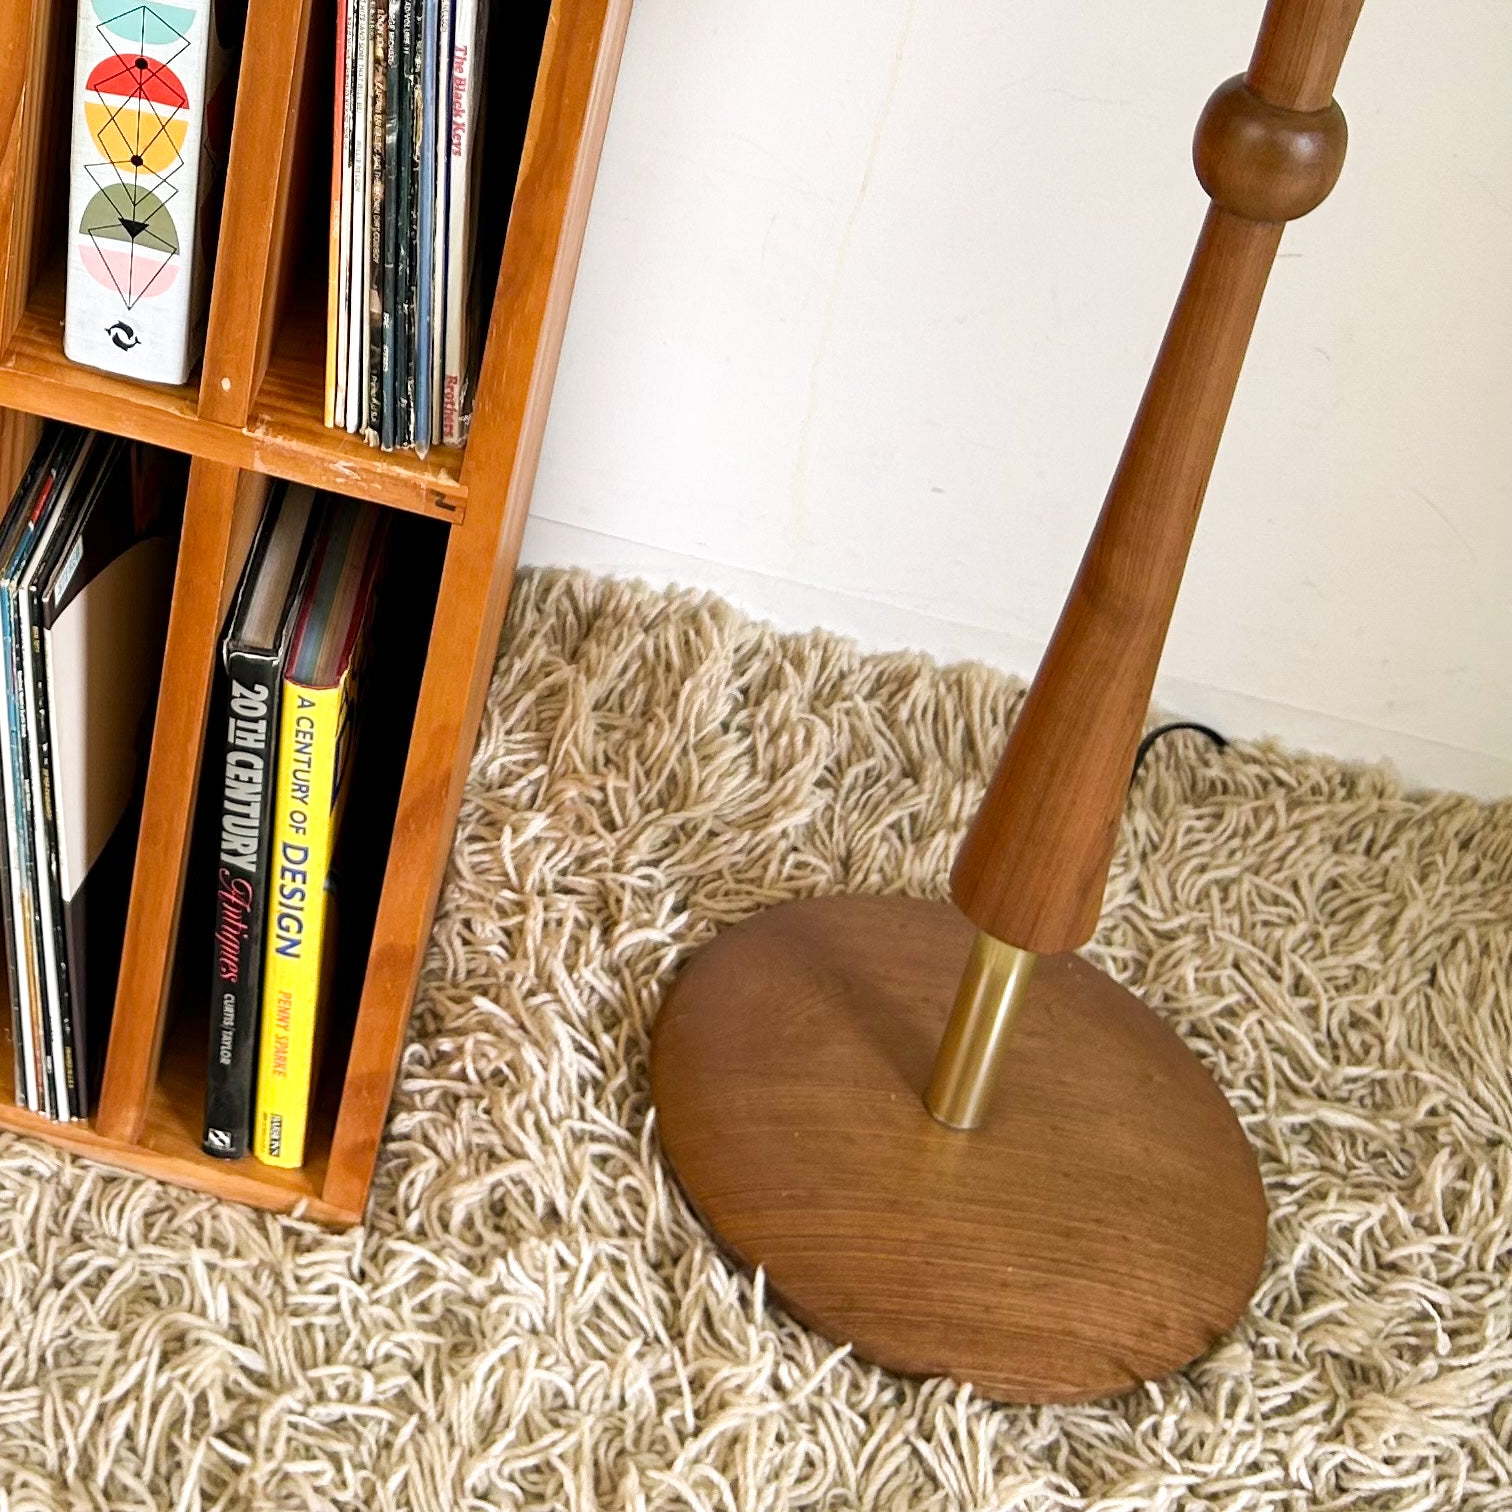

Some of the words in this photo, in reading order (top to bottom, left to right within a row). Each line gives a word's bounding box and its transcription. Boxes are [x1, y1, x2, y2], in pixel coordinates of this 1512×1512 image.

[453, 44, 467, 73] The
[450, 76, 467, 117] Black
[449, 121, 465, 156] Keys
[443, 374, 459, 438] Brothers
[228, 680, 269, 749] 20TH
[297, 695, 315, 709] A
[290, 717, 314, 805] CENTURY
[220, 752, 264, 872] CENTURY
[288, 810, 307, 835] OF
[275, 841, 308, 959] DESIGN
[215, 868, 253, 984] Antiques
[275, 990, 292, 1033] PENNY
[272, 1034, 289, 1078] SPARKE
